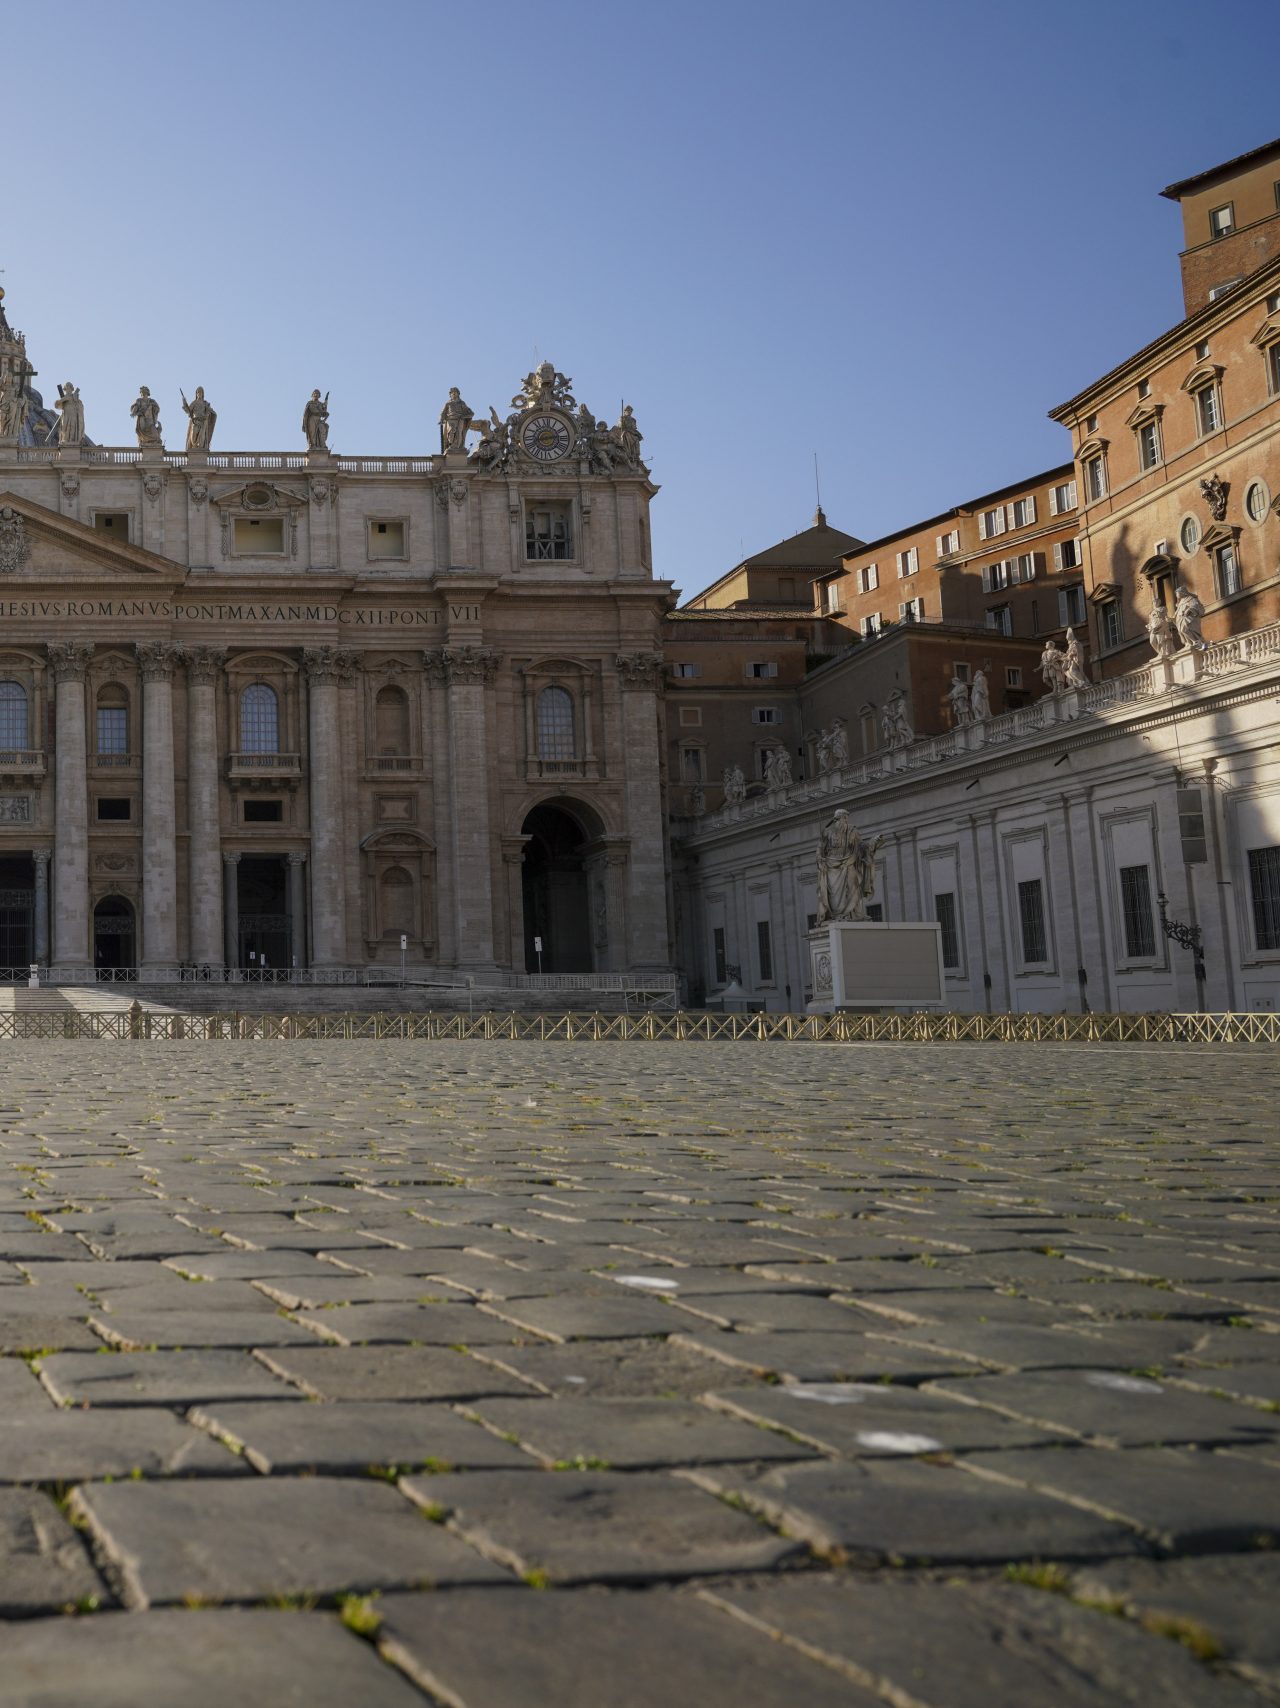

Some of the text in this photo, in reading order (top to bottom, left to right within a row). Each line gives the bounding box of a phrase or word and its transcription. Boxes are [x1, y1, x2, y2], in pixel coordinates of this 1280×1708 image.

[67, 601, 171, 616] ROMANVS
[173, 605, 226, 620] PONT
[228, 605, 270, 620] MAX
[275, 605, 301, 620] AN
[388, 610, 441, 624] PONT
[450, 606, 479, 620] VII
